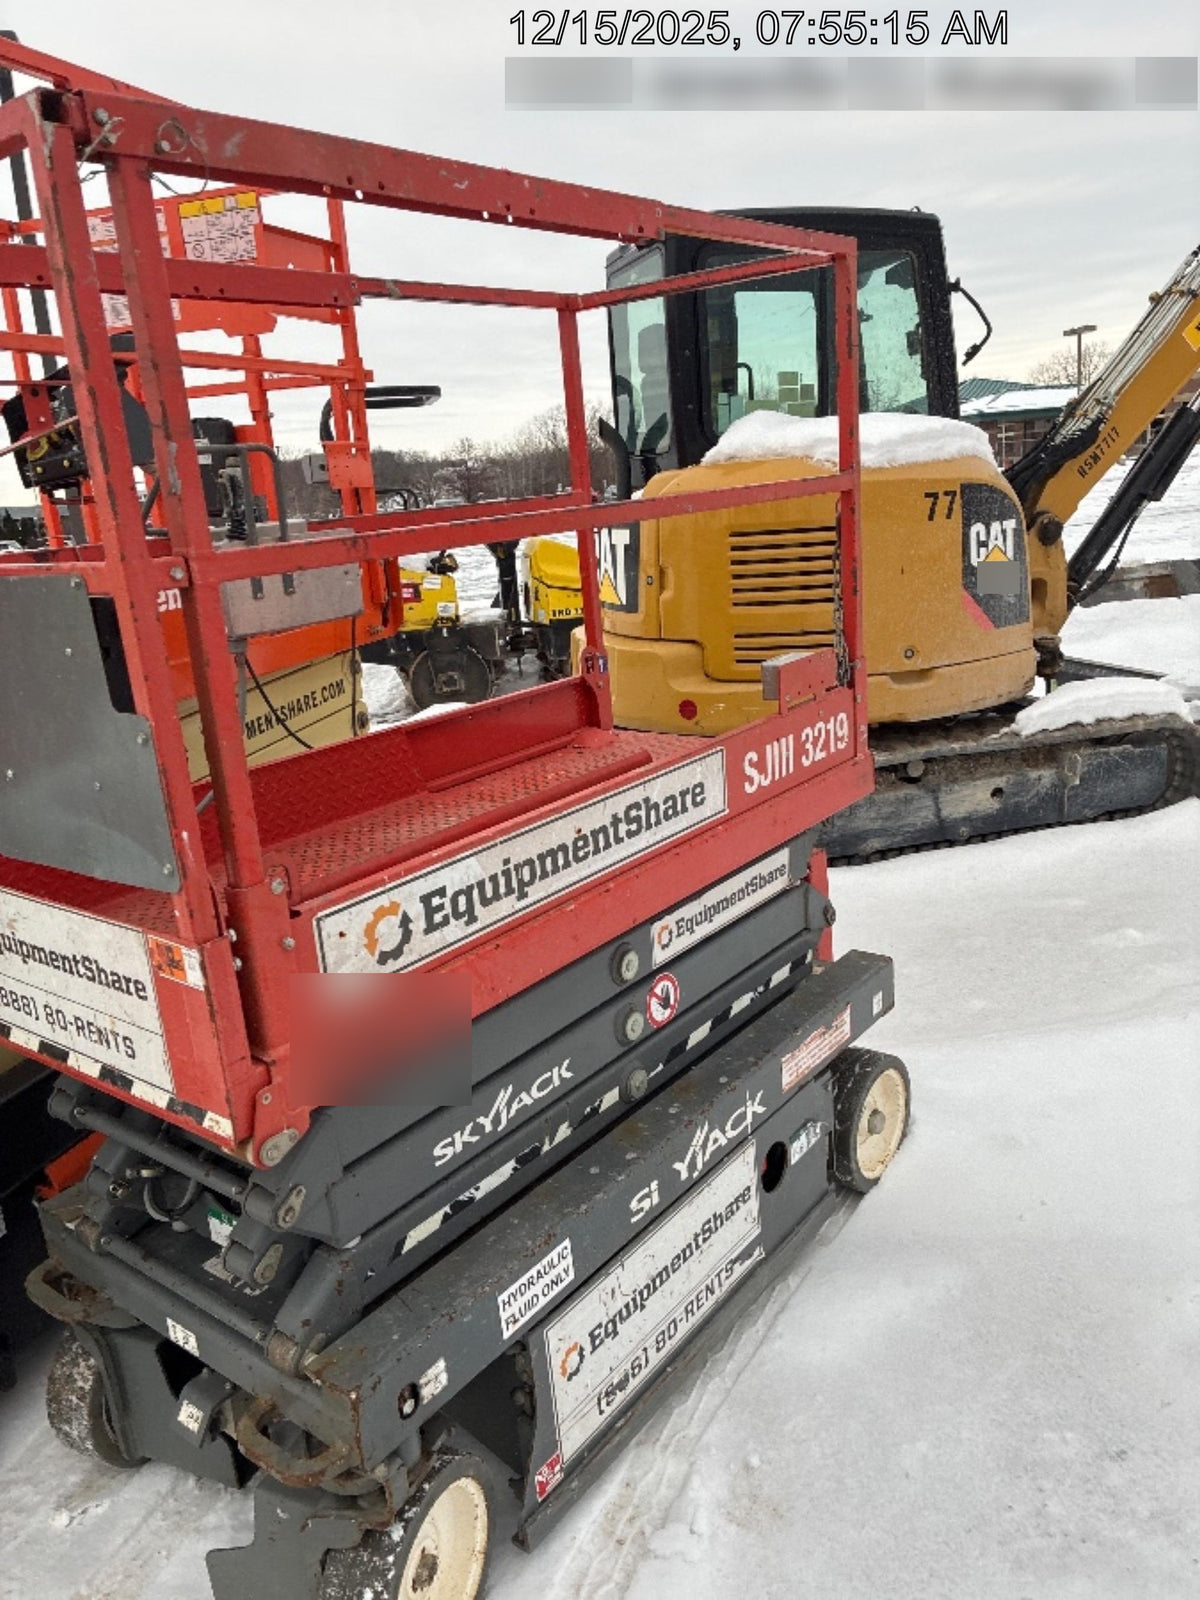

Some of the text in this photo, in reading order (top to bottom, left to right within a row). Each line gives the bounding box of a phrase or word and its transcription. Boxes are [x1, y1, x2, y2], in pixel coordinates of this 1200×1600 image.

[924, 490, 957, 521] 77
[594, 527, 627, 605] AT
[970, 519, 1016, 567] CAT
[801, 713, 849, 767] 3219
[419, 780, 706, 936] EquipmentShare
[675, 863, 787, 938] EquipmentShare
[0, 931, 148, 1001] uipmentShare
[44, 1003, 136, 1060] 80-RENTS
[433, 1058, 574, 1167] SKYJACK
[502, 1245, 570, 1312] HYDRAULIC
[505, 1264, 570, 1332] FLUID ONLY
[588, 1185, 752, 1354] EquipmentShare
[655, 1258, 735, 1353] 80-RENTS
